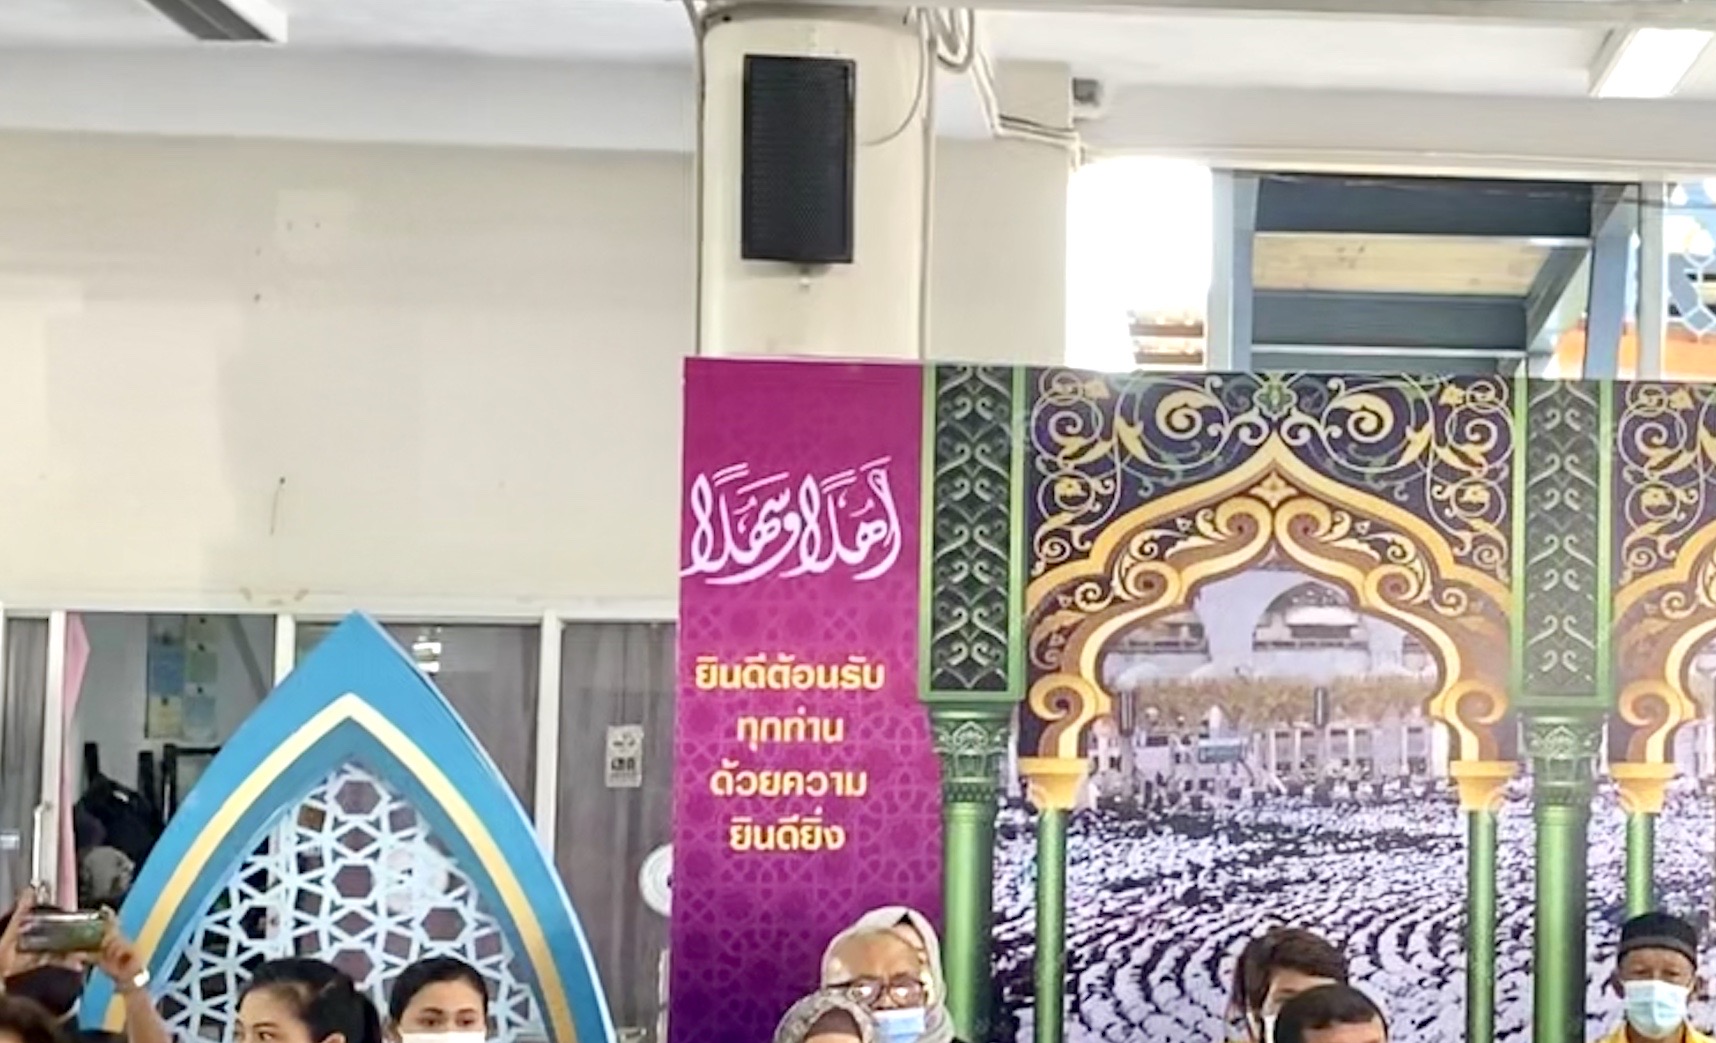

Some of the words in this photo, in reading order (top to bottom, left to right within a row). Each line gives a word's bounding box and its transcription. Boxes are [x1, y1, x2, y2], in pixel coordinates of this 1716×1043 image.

[695, 652, 886, 690] ยินดีต้อนรับ
[736, 706, 845, 752] ทุกท่าน
[709, 758, 868, 797] ด้วยความ
[729, 806, 847, 851] ยินดียิ่ง
